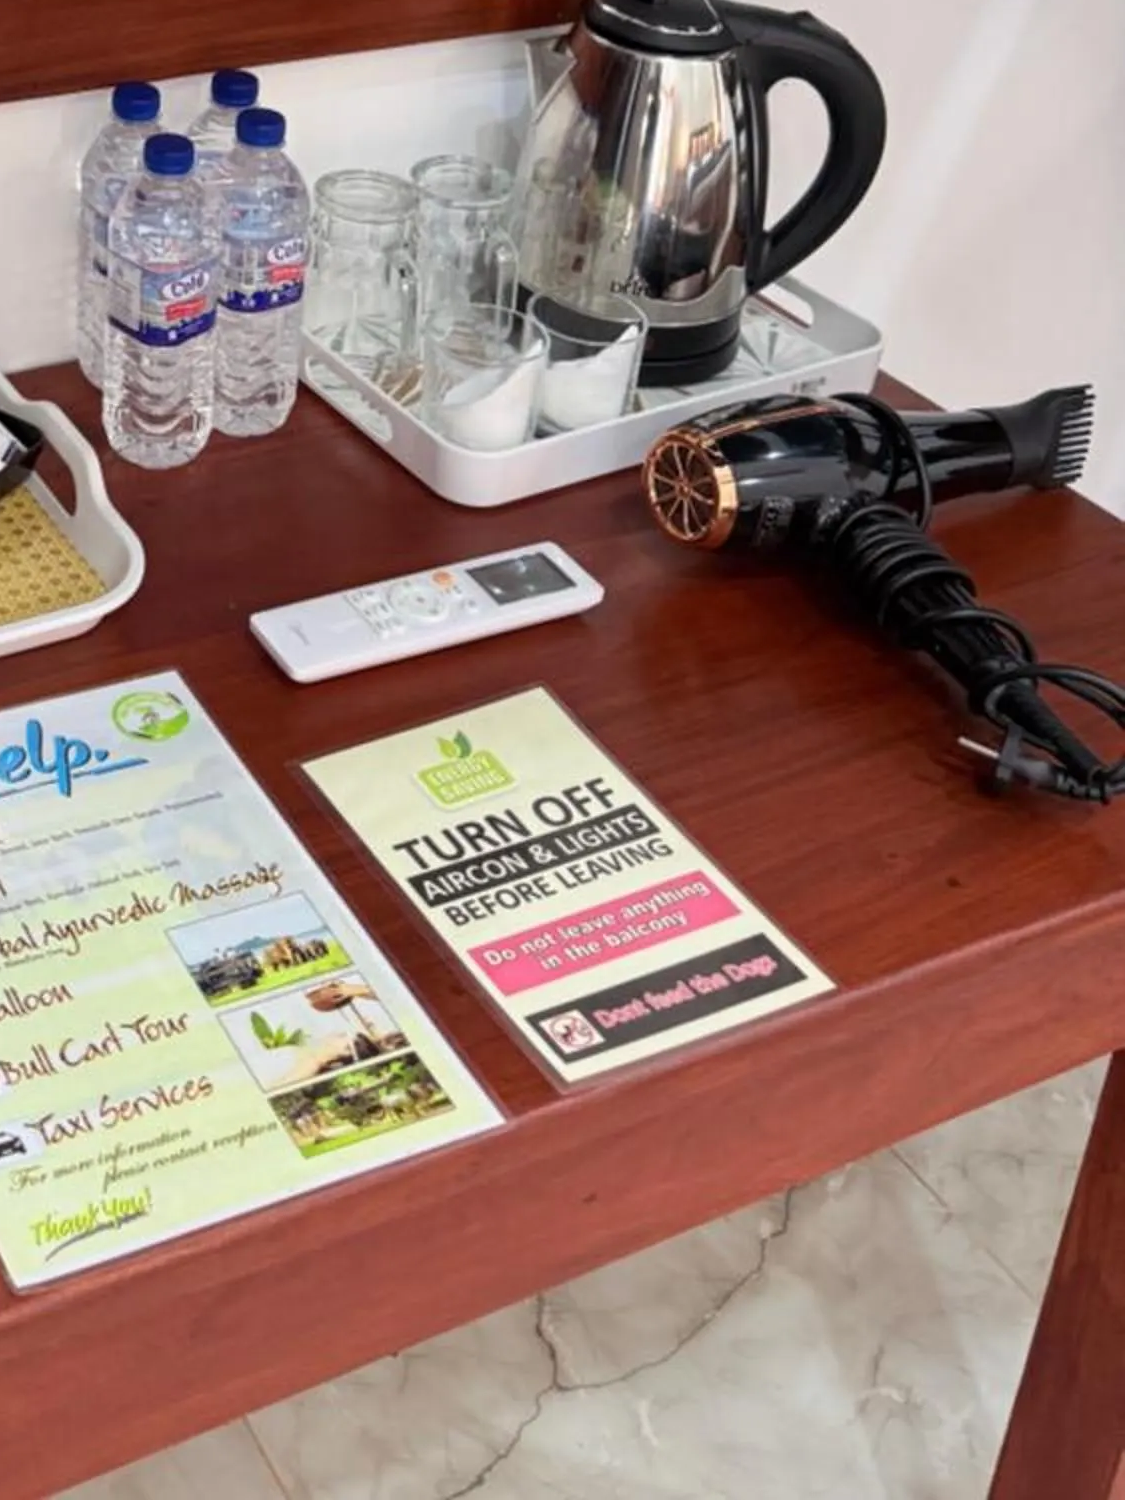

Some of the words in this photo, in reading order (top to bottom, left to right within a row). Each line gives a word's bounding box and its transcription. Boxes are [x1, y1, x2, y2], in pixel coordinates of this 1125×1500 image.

[432, 756, 492, 784] ENERGY
[440, 769, 506, 802] SAVING
[393, 809, 532, 870] TURN
[532, 777, 615, 827] OFF
[426, 852, 528, 900] AIRCON
[527, 844, 557, 865] &
[555, 811, 648, 855] LIGHTS
[444, 876, 558, 927] BEFORE
[555, 838, 674, 889] LEAVING
[43, 891, 167, 957] Ayurvedic
[169, 861, 283, 907] Massage
[483, 947, 516, 966] Do
[520, 933, 561, 954] not
[559, 912, 616, 942] leave
[621, 880, 712, 922] anything
[539, 955, 562, 971] in
[565, 938, 601, 962] the
[604, 910, 688, 948] balcony
[643, 980, 696, 1011] feed
[688, 969, 730, 995] the
[59, 1022, 123, 1067] Cart
[121, 1013, 190, 1045] Tour
[24, 1110, 93, 1146] Taxi
[99, 1075, 214, 1130] Services
[53, 1159, 93, 1179] more
[98, 1126, 191, 1175] information
[153, 1140, 208, 1167] contact
[30, 1204, 98, 1246] Thank
